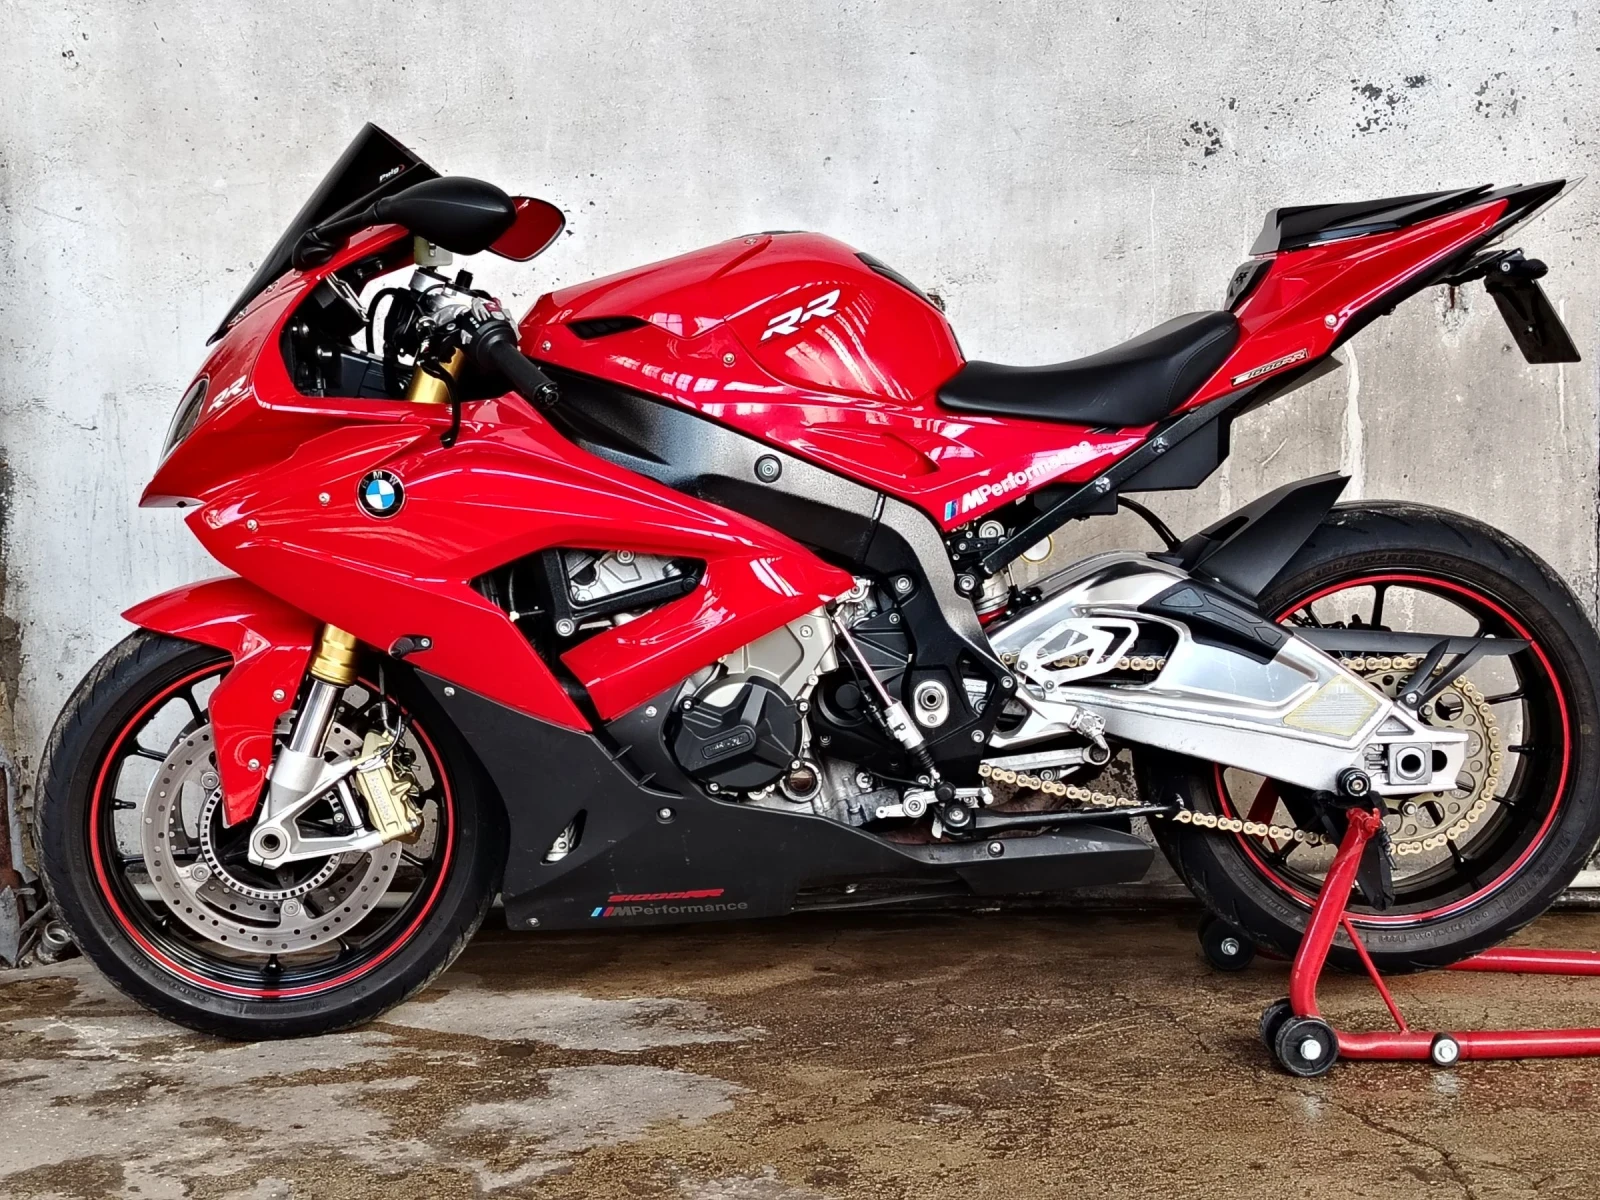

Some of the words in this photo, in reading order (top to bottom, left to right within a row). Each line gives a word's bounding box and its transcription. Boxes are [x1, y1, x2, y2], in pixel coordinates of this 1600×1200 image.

[760, 288, 840, 341] RR
[207, 374, 247, 414] RR
[360, 470, 400, 489] BMW
